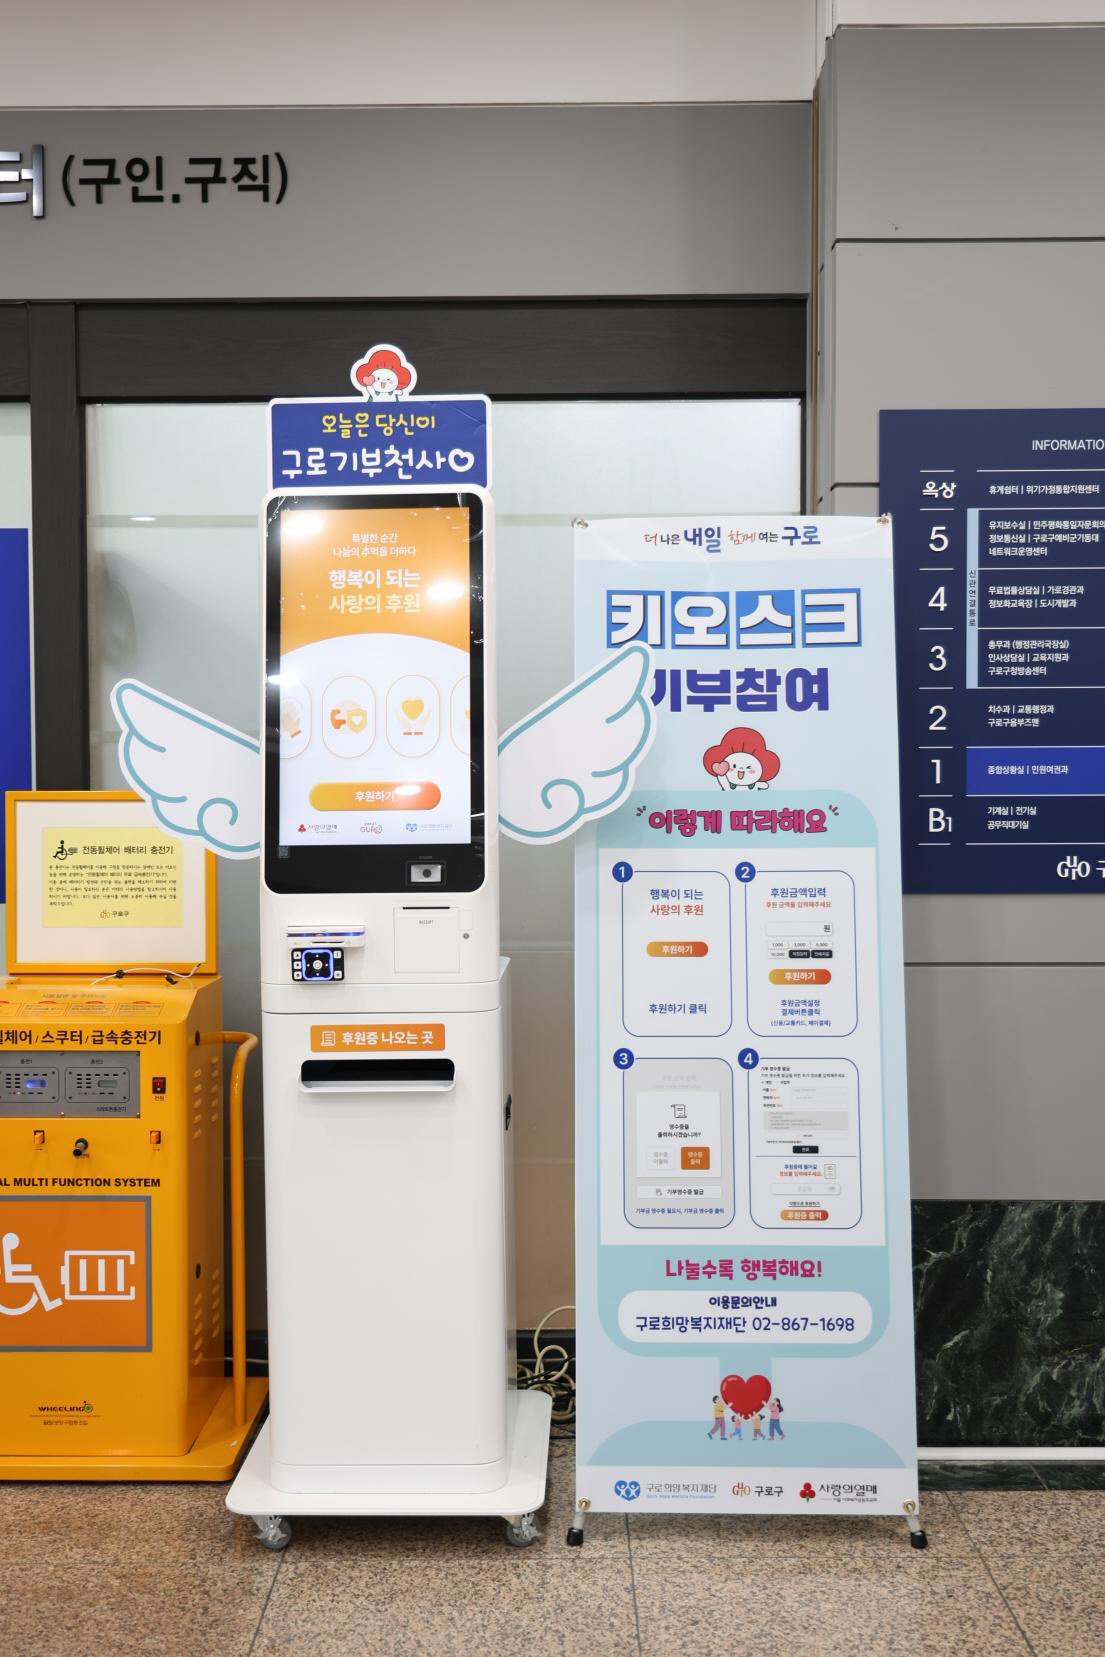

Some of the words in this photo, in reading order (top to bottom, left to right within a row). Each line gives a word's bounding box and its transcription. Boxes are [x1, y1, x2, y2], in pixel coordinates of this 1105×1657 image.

[61, 152, 289, 205] (구인.구직)
[322, 412, 370, 439] 오늘은
[375, 413, 436, 437] 당신이
[1032, 439, 1105, 451] INFORMATIO
[922, 481, 957, 499] 옥상
[988, 485, 1019, 495] 휴게쉼터
[1026, 484, 1100, 495] 위기가정통합지원센터
[988, 521, 1026, 530] 유지보수실
[351, 533, 378, 543] 특별한
[380, 533, 398, 543] 순간
[643, 532, 658, 546] 더
[660, 533, 681, 546] 나은
[684, 526, 722, 554] 내일
[727, 530, 756, 545] 함께
[758, 531, 779, 543] 여는
[781, 525, 821, 546] 구로
[929, 526, 949, 552] 5
[988, 534, 1026, 544] 정보통신실
[1032, 533, 1099, 543] 구로구예비군기동대
[332, 547, 360, 558] 나눔의
[361, 547, 388, 557] 추억을
[390, 546, 416, 556] 더하다
[988, 546, 1048, 556] 네트워크운영센터
[328, 569, 381, 589] 행복이
[385, 568, 421, 588] 되는
[988, 586, 1040, 595] 무료법률상담실
[1047, 586, 1084, 595] 가로경관과
[328, 594, 381, 614] 사랑의
[385, 594, 421, 613] 후원
[928, 586, 948, 611] 4
[988, 599, 1033, 608] 정보화교육장
[1040, 599, 1077, 608] 도시개발과
[609, 591, 861, 647] 키오스크
[988, 640, 1011, 650] 총무과
[928, 645, 947, 672] 3
[988, 653, 1025, 662] 인사상담실
[1032, 653, 1069, 662] 교육지원과
[988, 666, 1047, 676] 구로구청방송센터
[987, 705, 1010, 714] 치수과
[1017, 704, 1054, 714] 교통행정과
[928, 705, 947, 730] 2
[930, 759, 941, 784] 1
[987, 765, 1025, 775] 종합상황실
[1032, 765, 1069, 774] 민원여권과
[355, 790, 396, 803] 후원하기
[987, 806, 1009, 816] 기계실
[1016, 806, 1037, 815] 전기실
[648, 809, 723, 838] 이렇게
[730, 808, 829, 834] 따라해요
[928, 807, 953, 833] B1
[987, 820, 1030, 830] 공무직대기실
[124, 845, 147, 855] 배터리
[150, 845, 174, 855] 충전기
[618, 866, 627, 878] 1
[741, 866, 751, 878] 2
[650, 888, 681, 901] 행복이
[683, 888, 704, 901] 되는
[770, 887, 827, 899] 후원금액입력
[650, 904, 681, 916] 사랑의
[683, 904, 704, 916] 후원
[823, 924, 831, 933] 원
[662, 944, 693, 955] 후원하기
[783, 971, 816, 981] 후원하기
[648, 1003, 687, 1015] 후원하기
[689, 1003, 708, 1015] 클릭
[781, 999, 821, 1008] 후원금액설정
[781, 1008, 821, 1016] 결제버튼클릭
[342, 1031, 379, 1045] 후원증
[381, 1031, 419, 1045] 나오는
[421, 1031, 434, 1045] 곳
[619, 1053, 628, 1064] 3
[743, 1053, 753, 1064] 4
[13, 1178, 49, 1187] MULTI
[52, 1178, 111, 1187] FUNCTION
[114, 1177, 161, 1187] SYSTEM
[665, 1259, 734, 1281] 나눌수록
[740, 1258, 823, 1281] 행복해요!
[708, 1295, 778, 1309] 이용문의안내
[635, 1315, 747, 1333] 구로희망복지재단
[752, 1316, 855, 1332] 02-867-1698
[754, 1485, 784, 1498] 구로구
[818, 1482, 878, 1497] 사랑의열매
